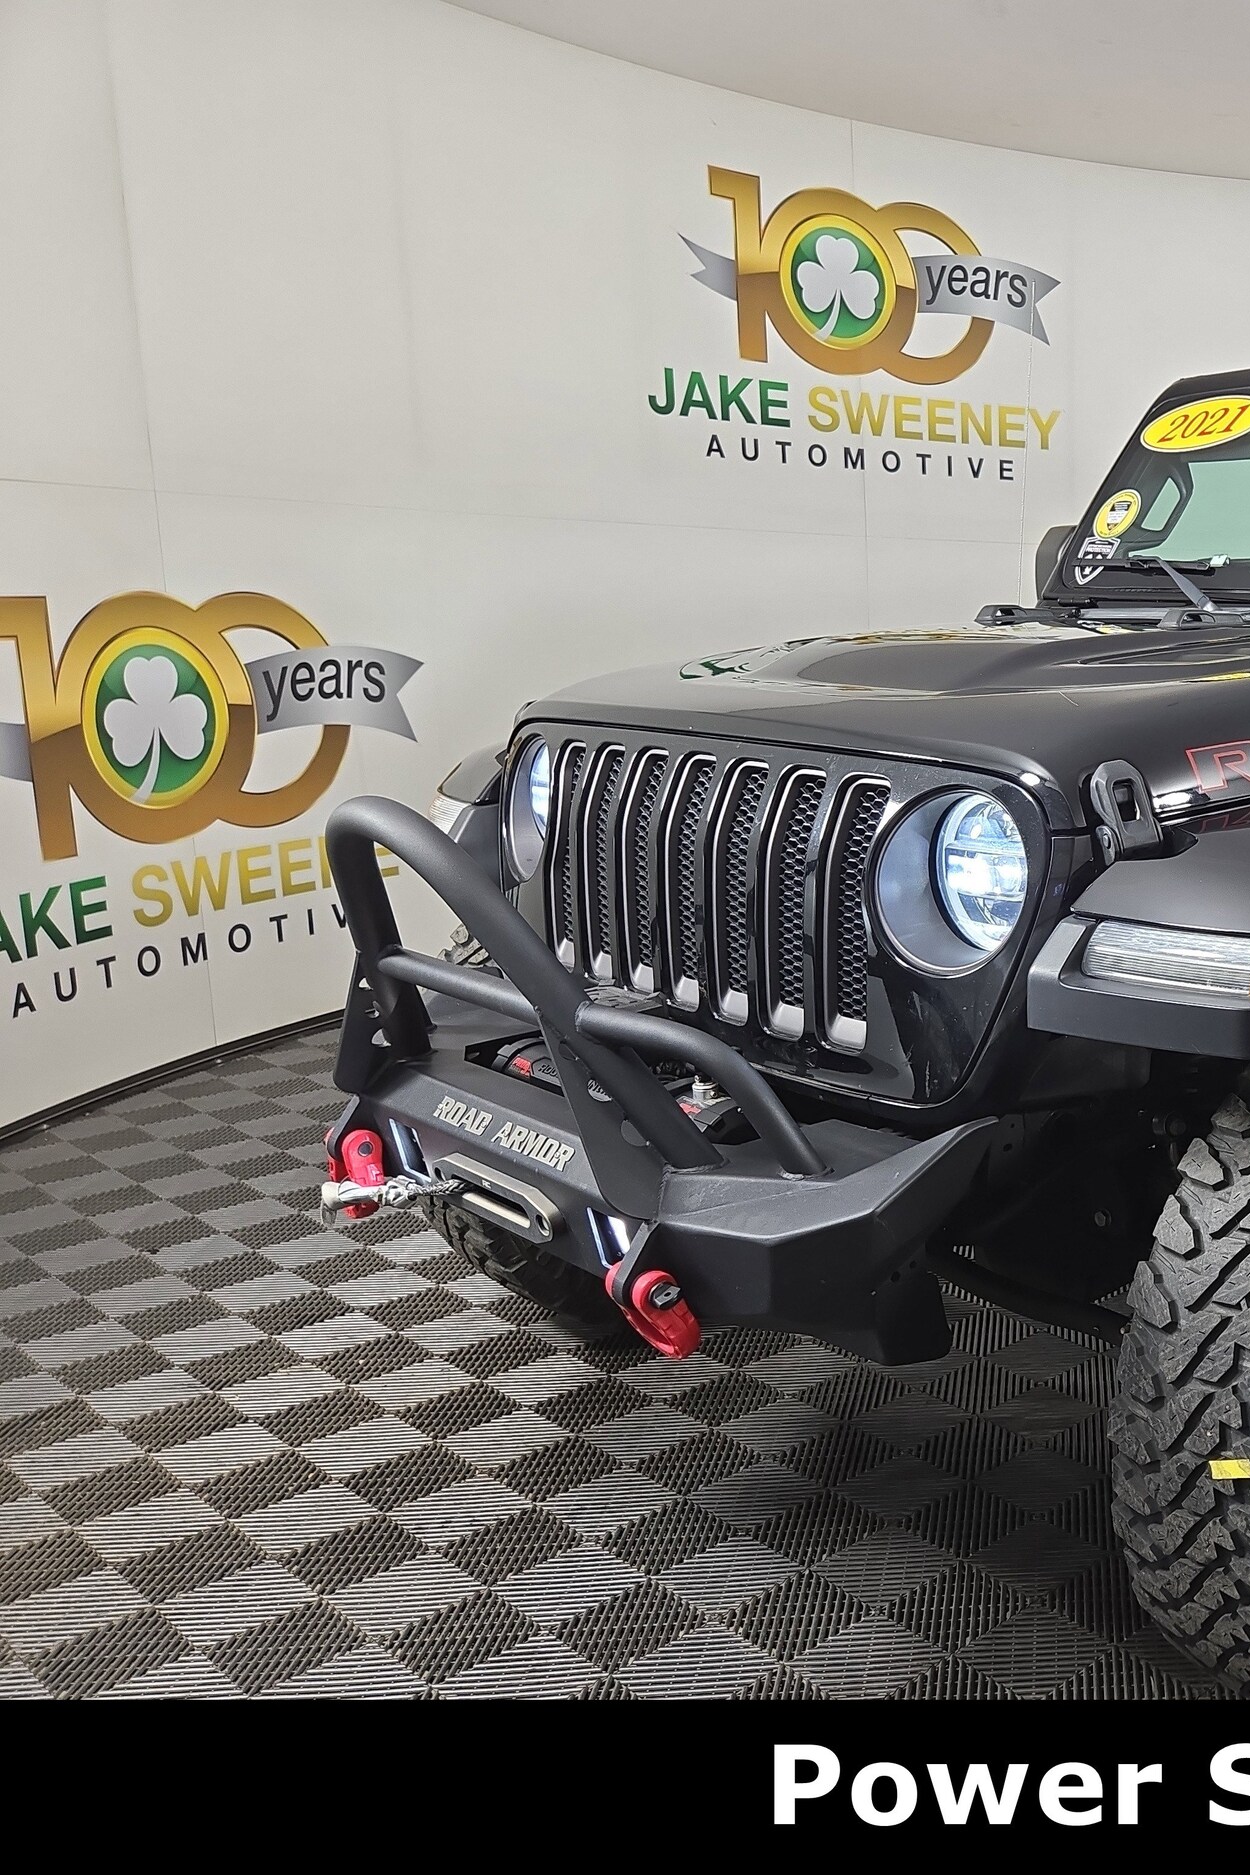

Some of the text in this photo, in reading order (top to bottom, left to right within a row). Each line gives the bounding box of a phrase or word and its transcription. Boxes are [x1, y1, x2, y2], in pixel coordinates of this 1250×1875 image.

[926, 264, 1028, 308] years
[648, 368, 1062, 450] JAKE SWEENEY
[1157, 404, 1250, 443] 2021
[706, 435, 1014, 481] AUTOMOTIVE
[262, 656, 387, 721] years
[0, 876, 113, 964] AKE
[12, 903, 347, 1018] AUTOMOTIV
[434, 1095, 576, 1172] ROAD ARMOR
